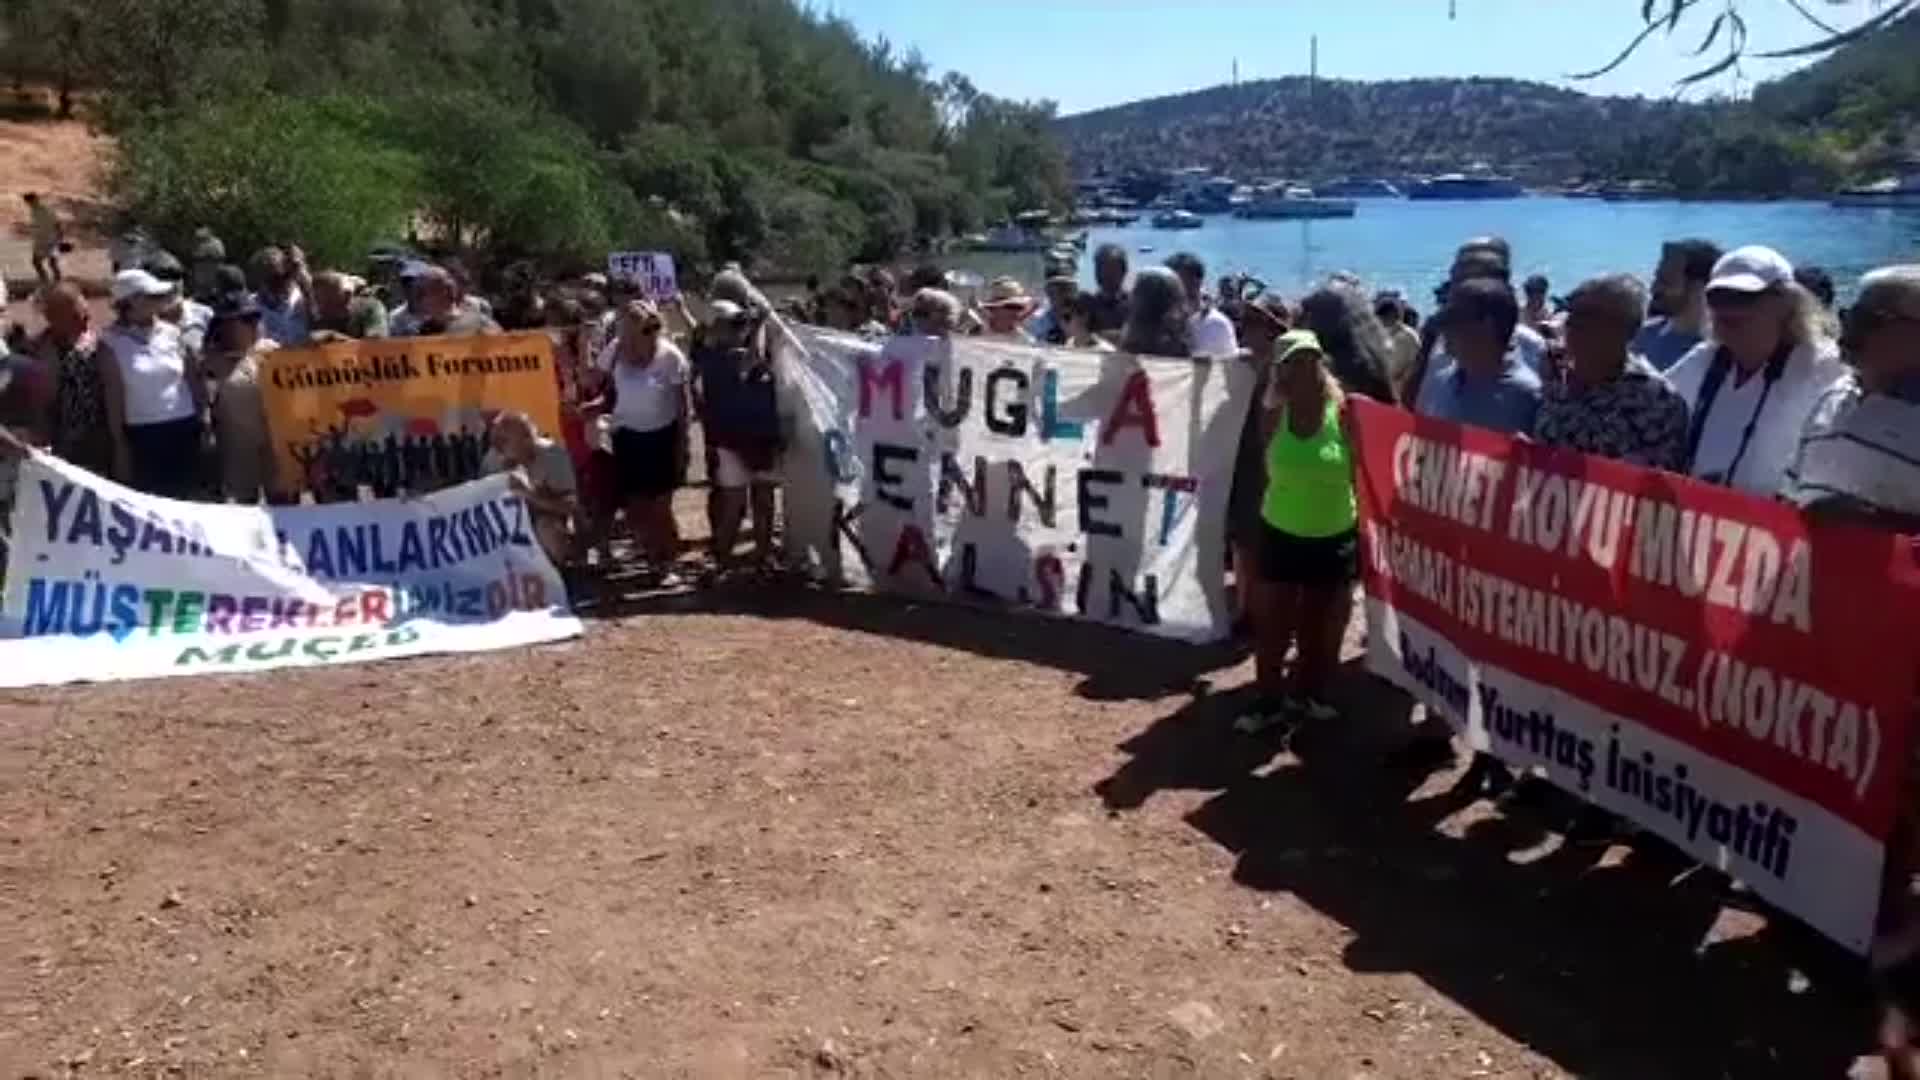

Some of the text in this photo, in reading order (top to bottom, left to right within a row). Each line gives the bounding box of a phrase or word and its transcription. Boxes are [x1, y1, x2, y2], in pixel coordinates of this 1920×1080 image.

[272, 350, 541, 390] Gümüşlük Forumu
[1394, 432, 1812, 632] CENNET KOYU'MUZDA
[1478, 681, 1595, 792] Yurttaş
[1607, 722, 1798, 880] İnisiyatifi
